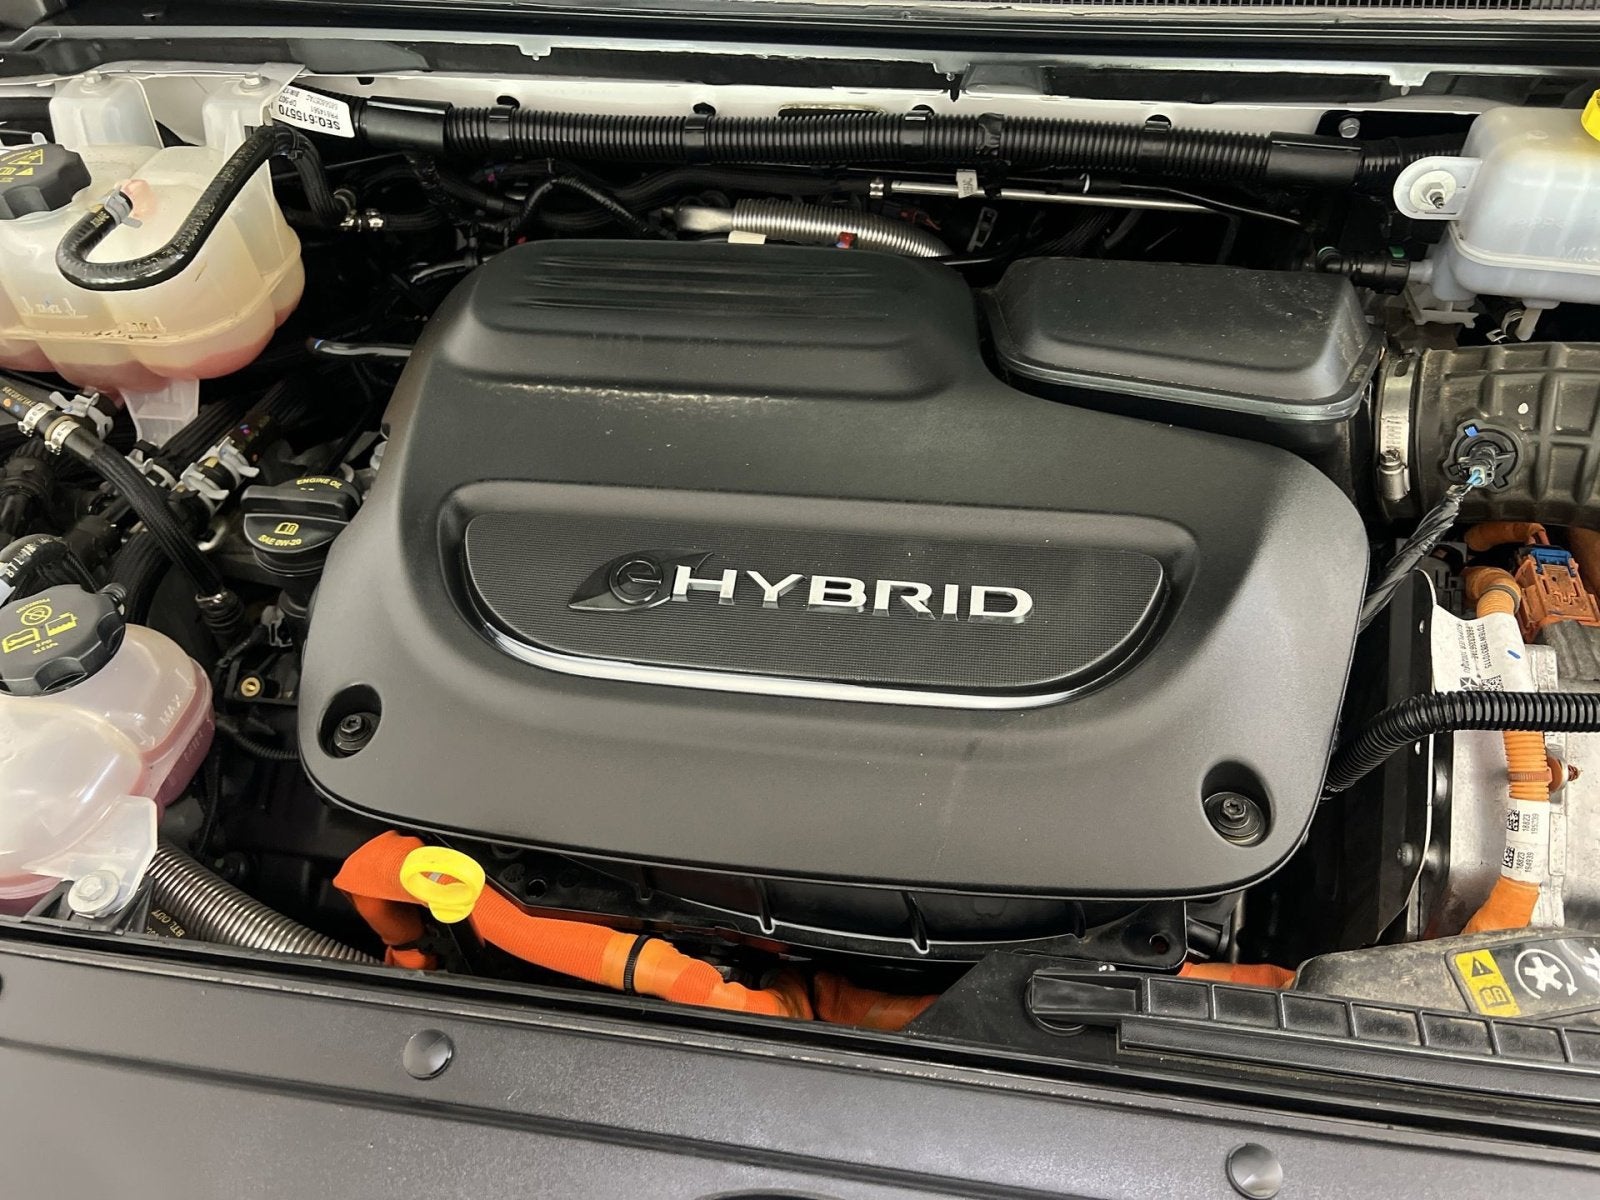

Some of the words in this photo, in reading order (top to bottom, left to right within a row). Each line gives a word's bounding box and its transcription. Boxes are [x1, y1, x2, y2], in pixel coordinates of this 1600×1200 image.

[278, 104, 341, 130] SEQ:615570
[296, 477, 331, 486] ENGINE
[329, 478, 343, 489] OIL
[258, 534, 276, 546] SAE
